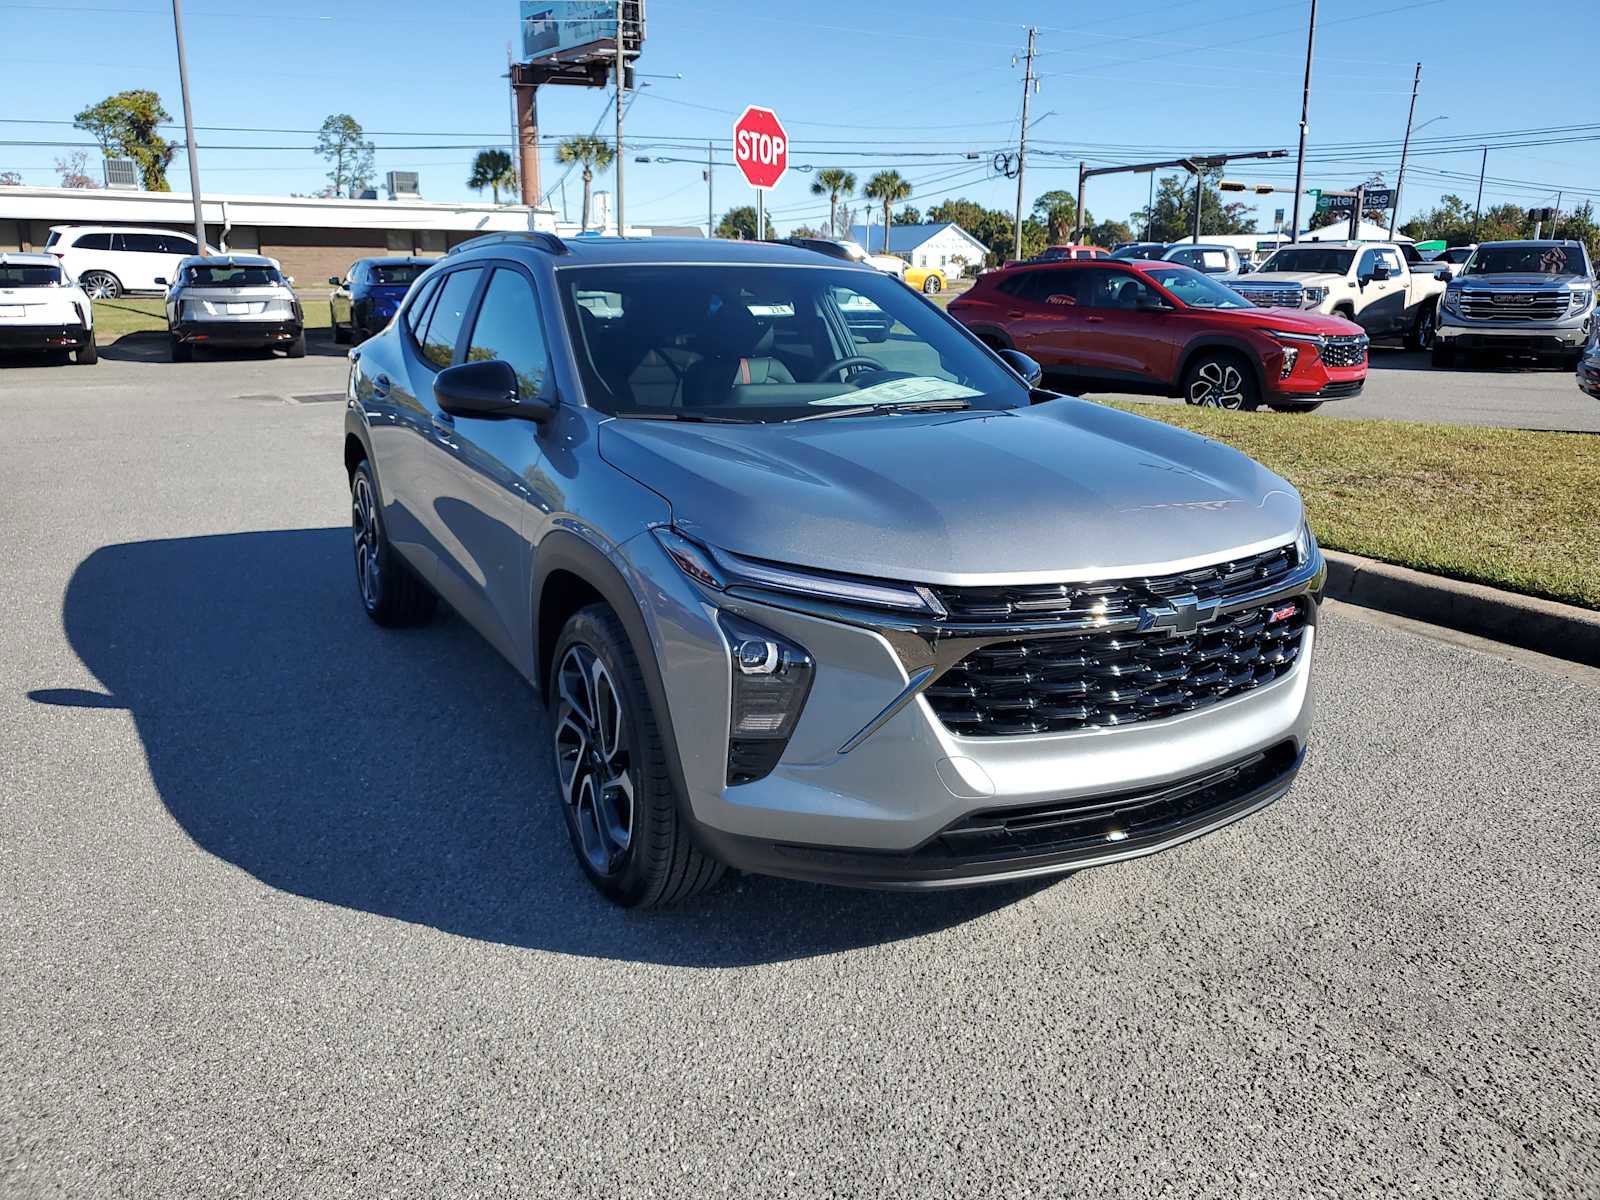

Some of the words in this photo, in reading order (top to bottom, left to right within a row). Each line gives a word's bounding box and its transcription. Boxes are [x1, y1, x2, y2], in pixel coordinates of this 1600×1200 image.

[737, 129, 785, 166] STOP
[1319, 194, 1389, 207] enterrise
[1493, 294, 1534, 303] GMC
